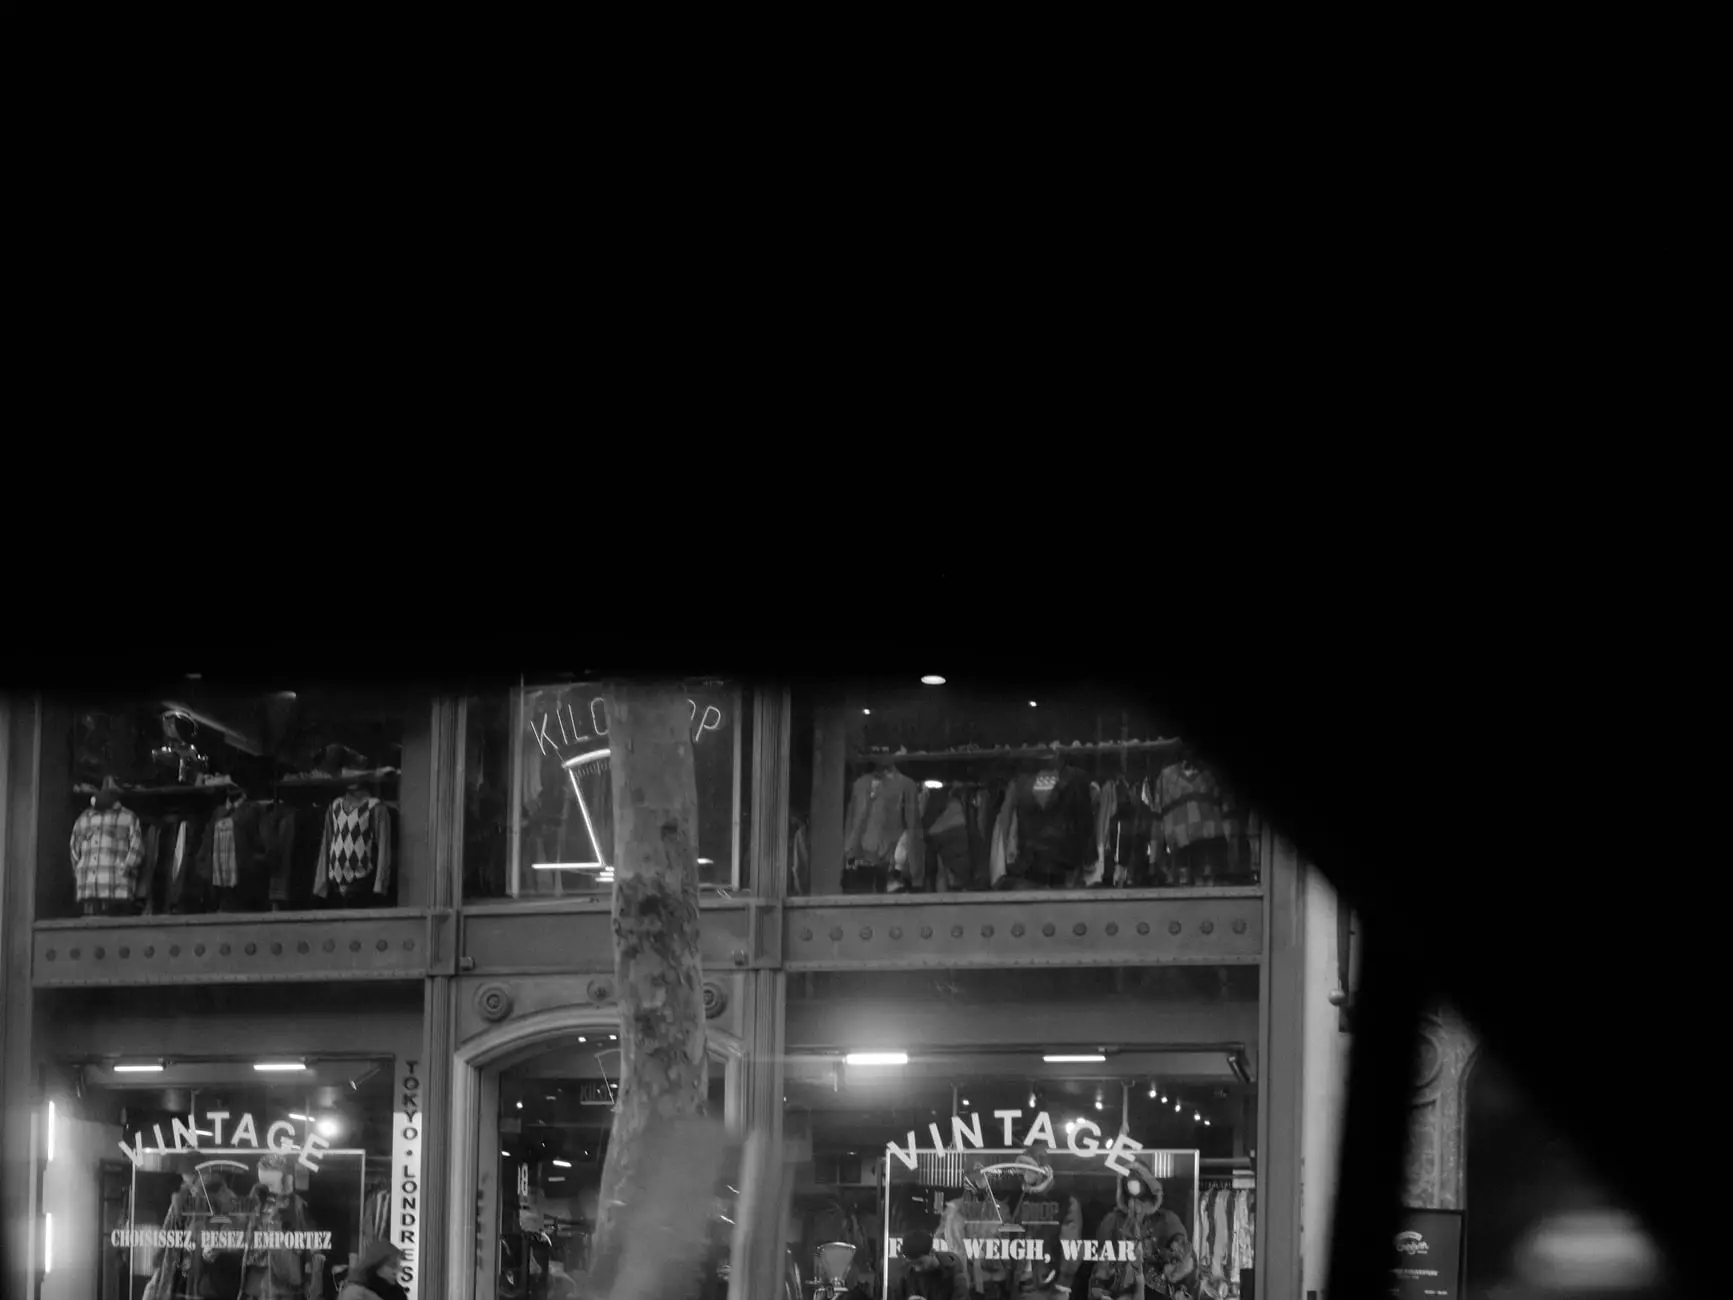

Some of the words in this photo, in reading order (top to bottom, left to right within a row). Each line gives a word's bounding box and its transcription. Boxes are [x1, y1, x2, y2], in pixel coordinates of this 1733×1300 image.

[403, 1060, 419, 1140] TOKYO
[118, 1111, 330, 1173] VINTAGE
[887, 1109, 1143, 1177] VINTAGE
[110, 1230, 196, 1251] CHOISISSEZ,
[253, 1231, 332, 1250] EMPORTEZ
[400, 1164, 417, 1283] LONDRES
[963, 1238, 1051, 1263] WEIGH,
[1060, 1239, 1137, 1262] WEAR
